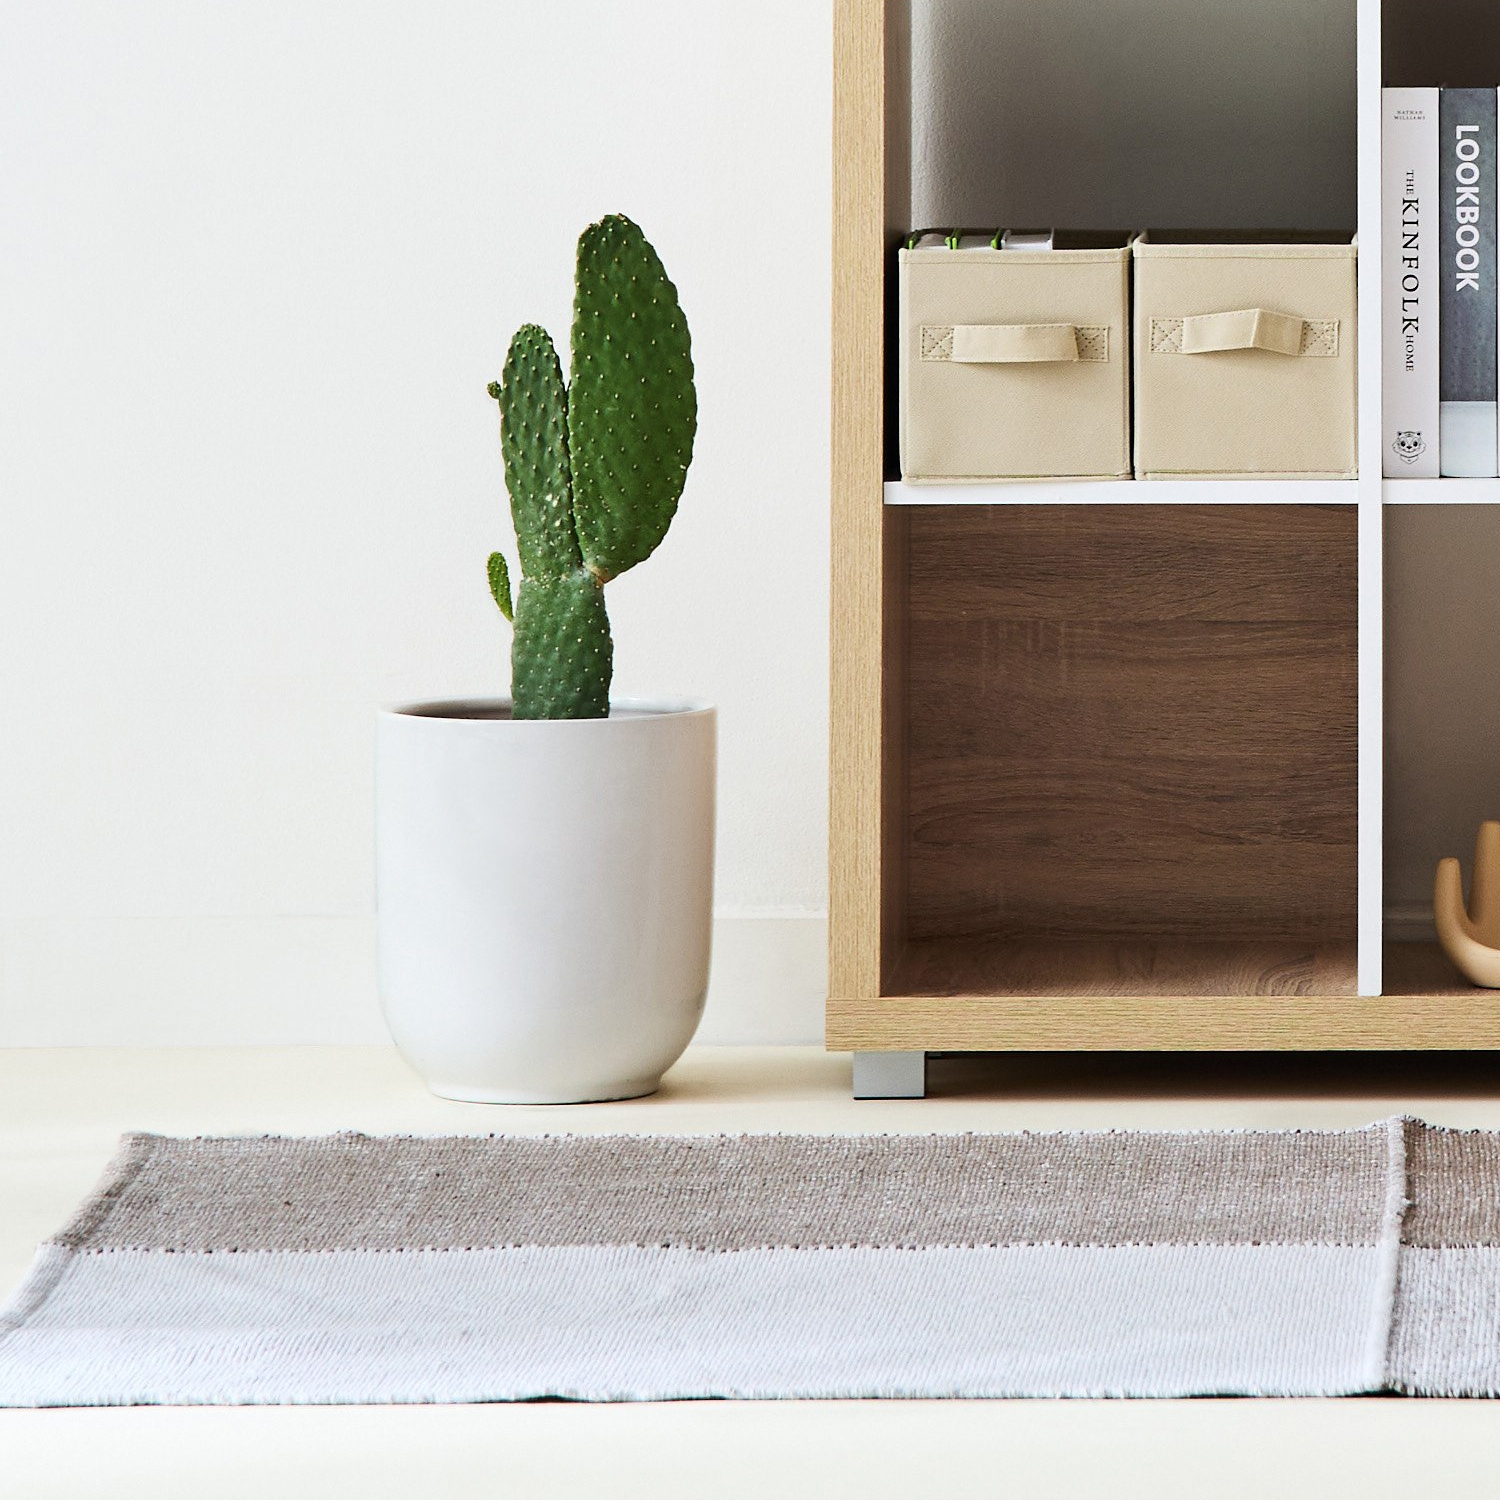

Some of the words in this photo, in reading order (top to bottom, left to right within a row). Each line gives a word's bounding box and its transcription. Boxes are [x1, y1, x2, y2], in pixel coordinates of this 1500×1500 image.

[1406, 169, 1415, 195] THE
[1455, 125, 1480, 292] LOOKBOOK
[1402, 197, 1420, 334] KINFOLK
[1405, 335, 1415, 372] HOME
